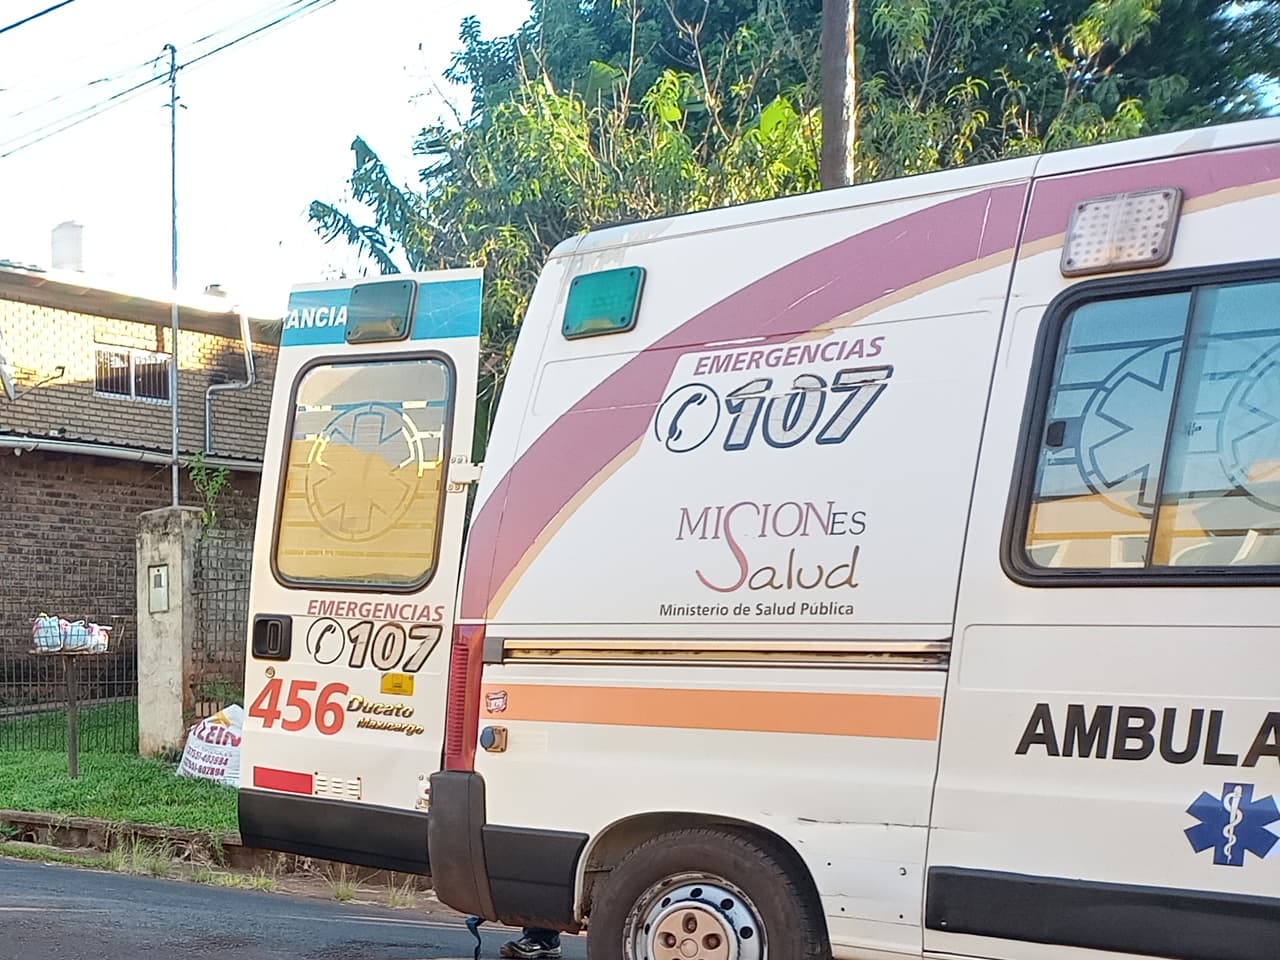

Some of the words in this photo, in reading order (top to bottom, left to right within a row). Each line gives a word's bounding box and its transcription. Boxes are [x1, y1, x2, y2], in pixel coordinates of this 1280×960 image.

[693, 336, 885, 376] EMERGENCIAS
[723, 365, 894, 451] 107
[695, 530, 860, 593] Salud
[307, 600, 445, 622] EMERGENCIAS
[659, 603, 729, 617] Ministerio
[733, 603, 751, 616] de
[755, 602, 796, 616] Salud
[800, 602, 854, 616] Pública
[347, 620, 443, 673] 107
[248, 678, 350, 735] 456
[346, 695, 415, 719] Ducato
[1015, 703, 1280, 767] AMBULA
